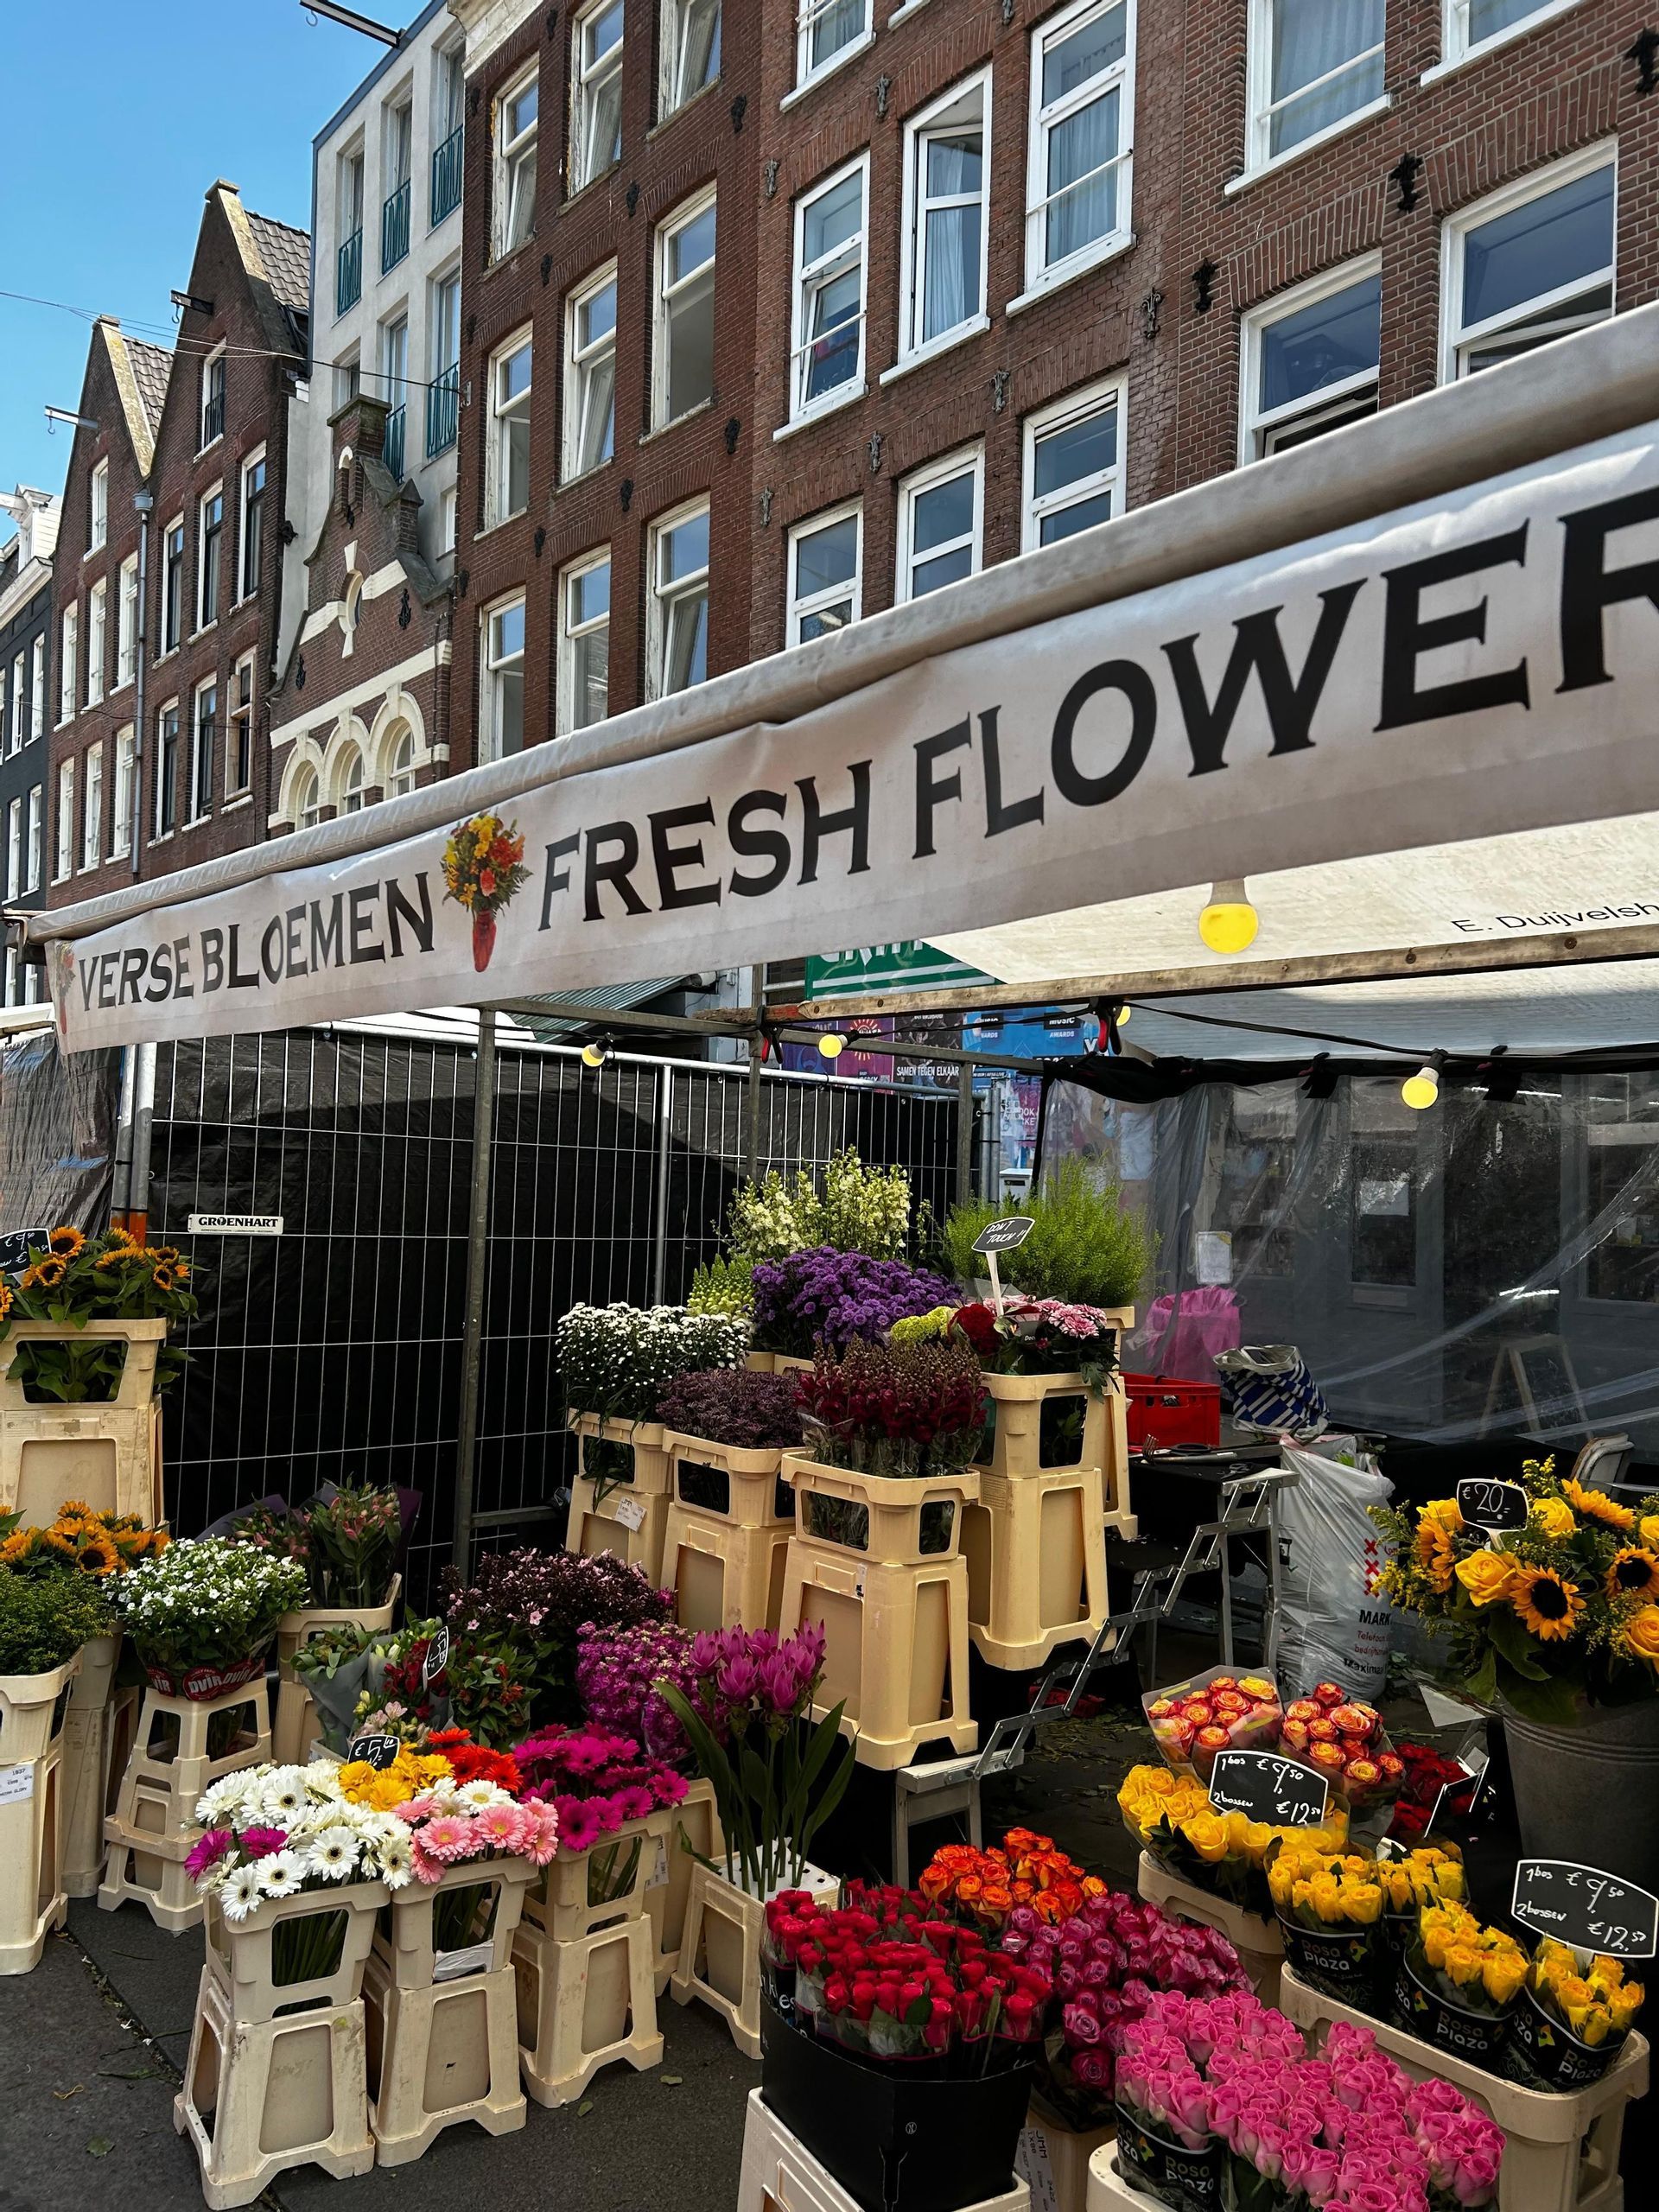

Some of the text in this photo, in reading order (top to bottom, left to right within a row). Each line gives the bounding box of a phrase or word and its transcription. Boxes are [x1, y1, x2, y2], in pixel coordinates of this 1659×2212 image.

[78, 934, 194, 1011] VERSE
[200, 871, 435, 994] BLOEMEN
[537, 759, 873, 931] FRESH
[1451, 918, 1493, 932] E.
[896, 1065, 917, 1077] SAMEN
[917, 1065, 935, 1077] TEGEN
[936, 1065, 960, 1077] ELKAAR
[198, 1216, 279, 1227] GROENHART
[1304, 1951, 1350, 1971] Plaza
[1436, 2022, 1488, 2050] Plaza
